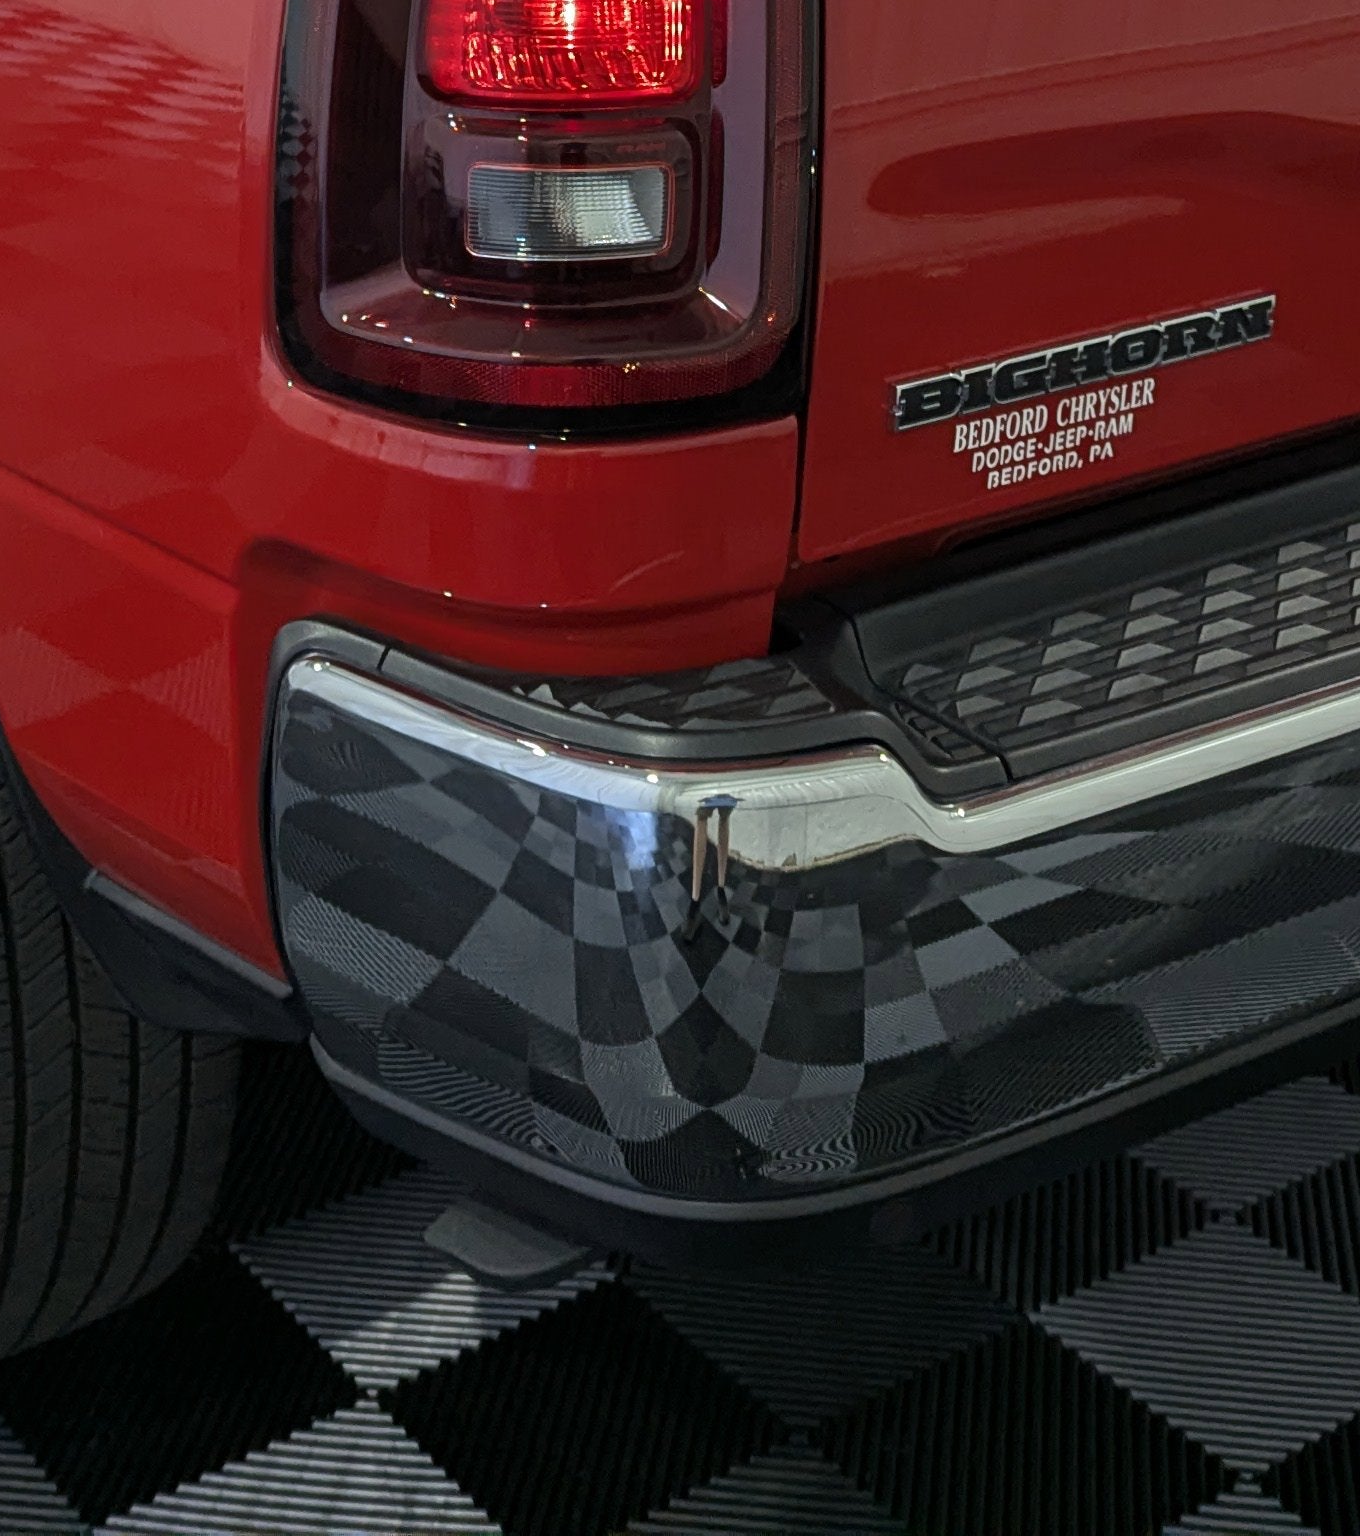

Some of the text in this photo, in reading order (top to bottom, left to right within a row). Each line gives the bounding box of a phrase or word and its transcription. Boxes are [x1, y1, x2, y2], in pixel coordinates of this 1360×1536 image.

[953, 378, 1156, 453] BEDFORD CHRYSLER
[1089, 441, 1114, 462] PA
